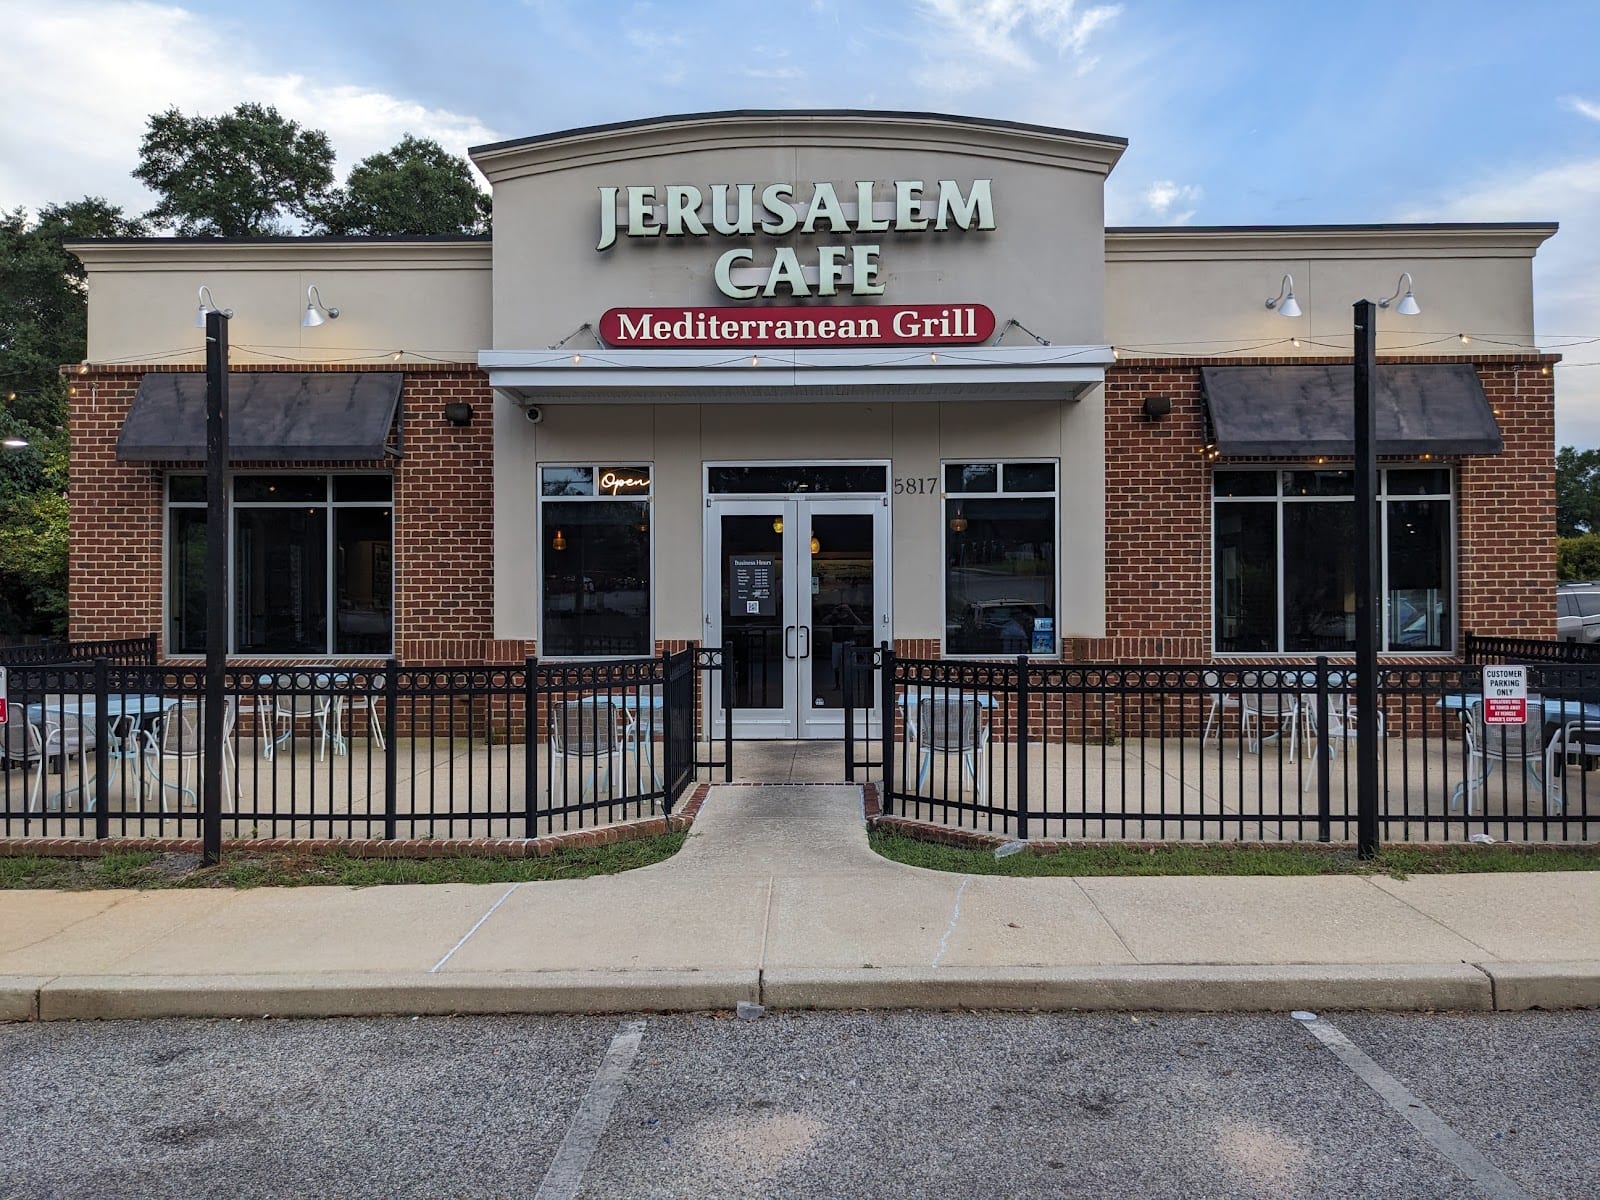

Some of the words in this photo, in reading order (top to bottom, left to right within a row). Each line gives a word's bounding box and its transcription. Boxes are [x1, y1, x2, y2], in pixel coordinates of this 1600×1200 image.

[595, 178, 997, 251] JERUSALEM
[713, 244, 887, 299] CAFE
[617, 312, 881, 340] Mediterranean
[893, 308, 977, 338] Grill
[601, 473, 651, 496] Open
[894, 477, 937, 494] 5817
